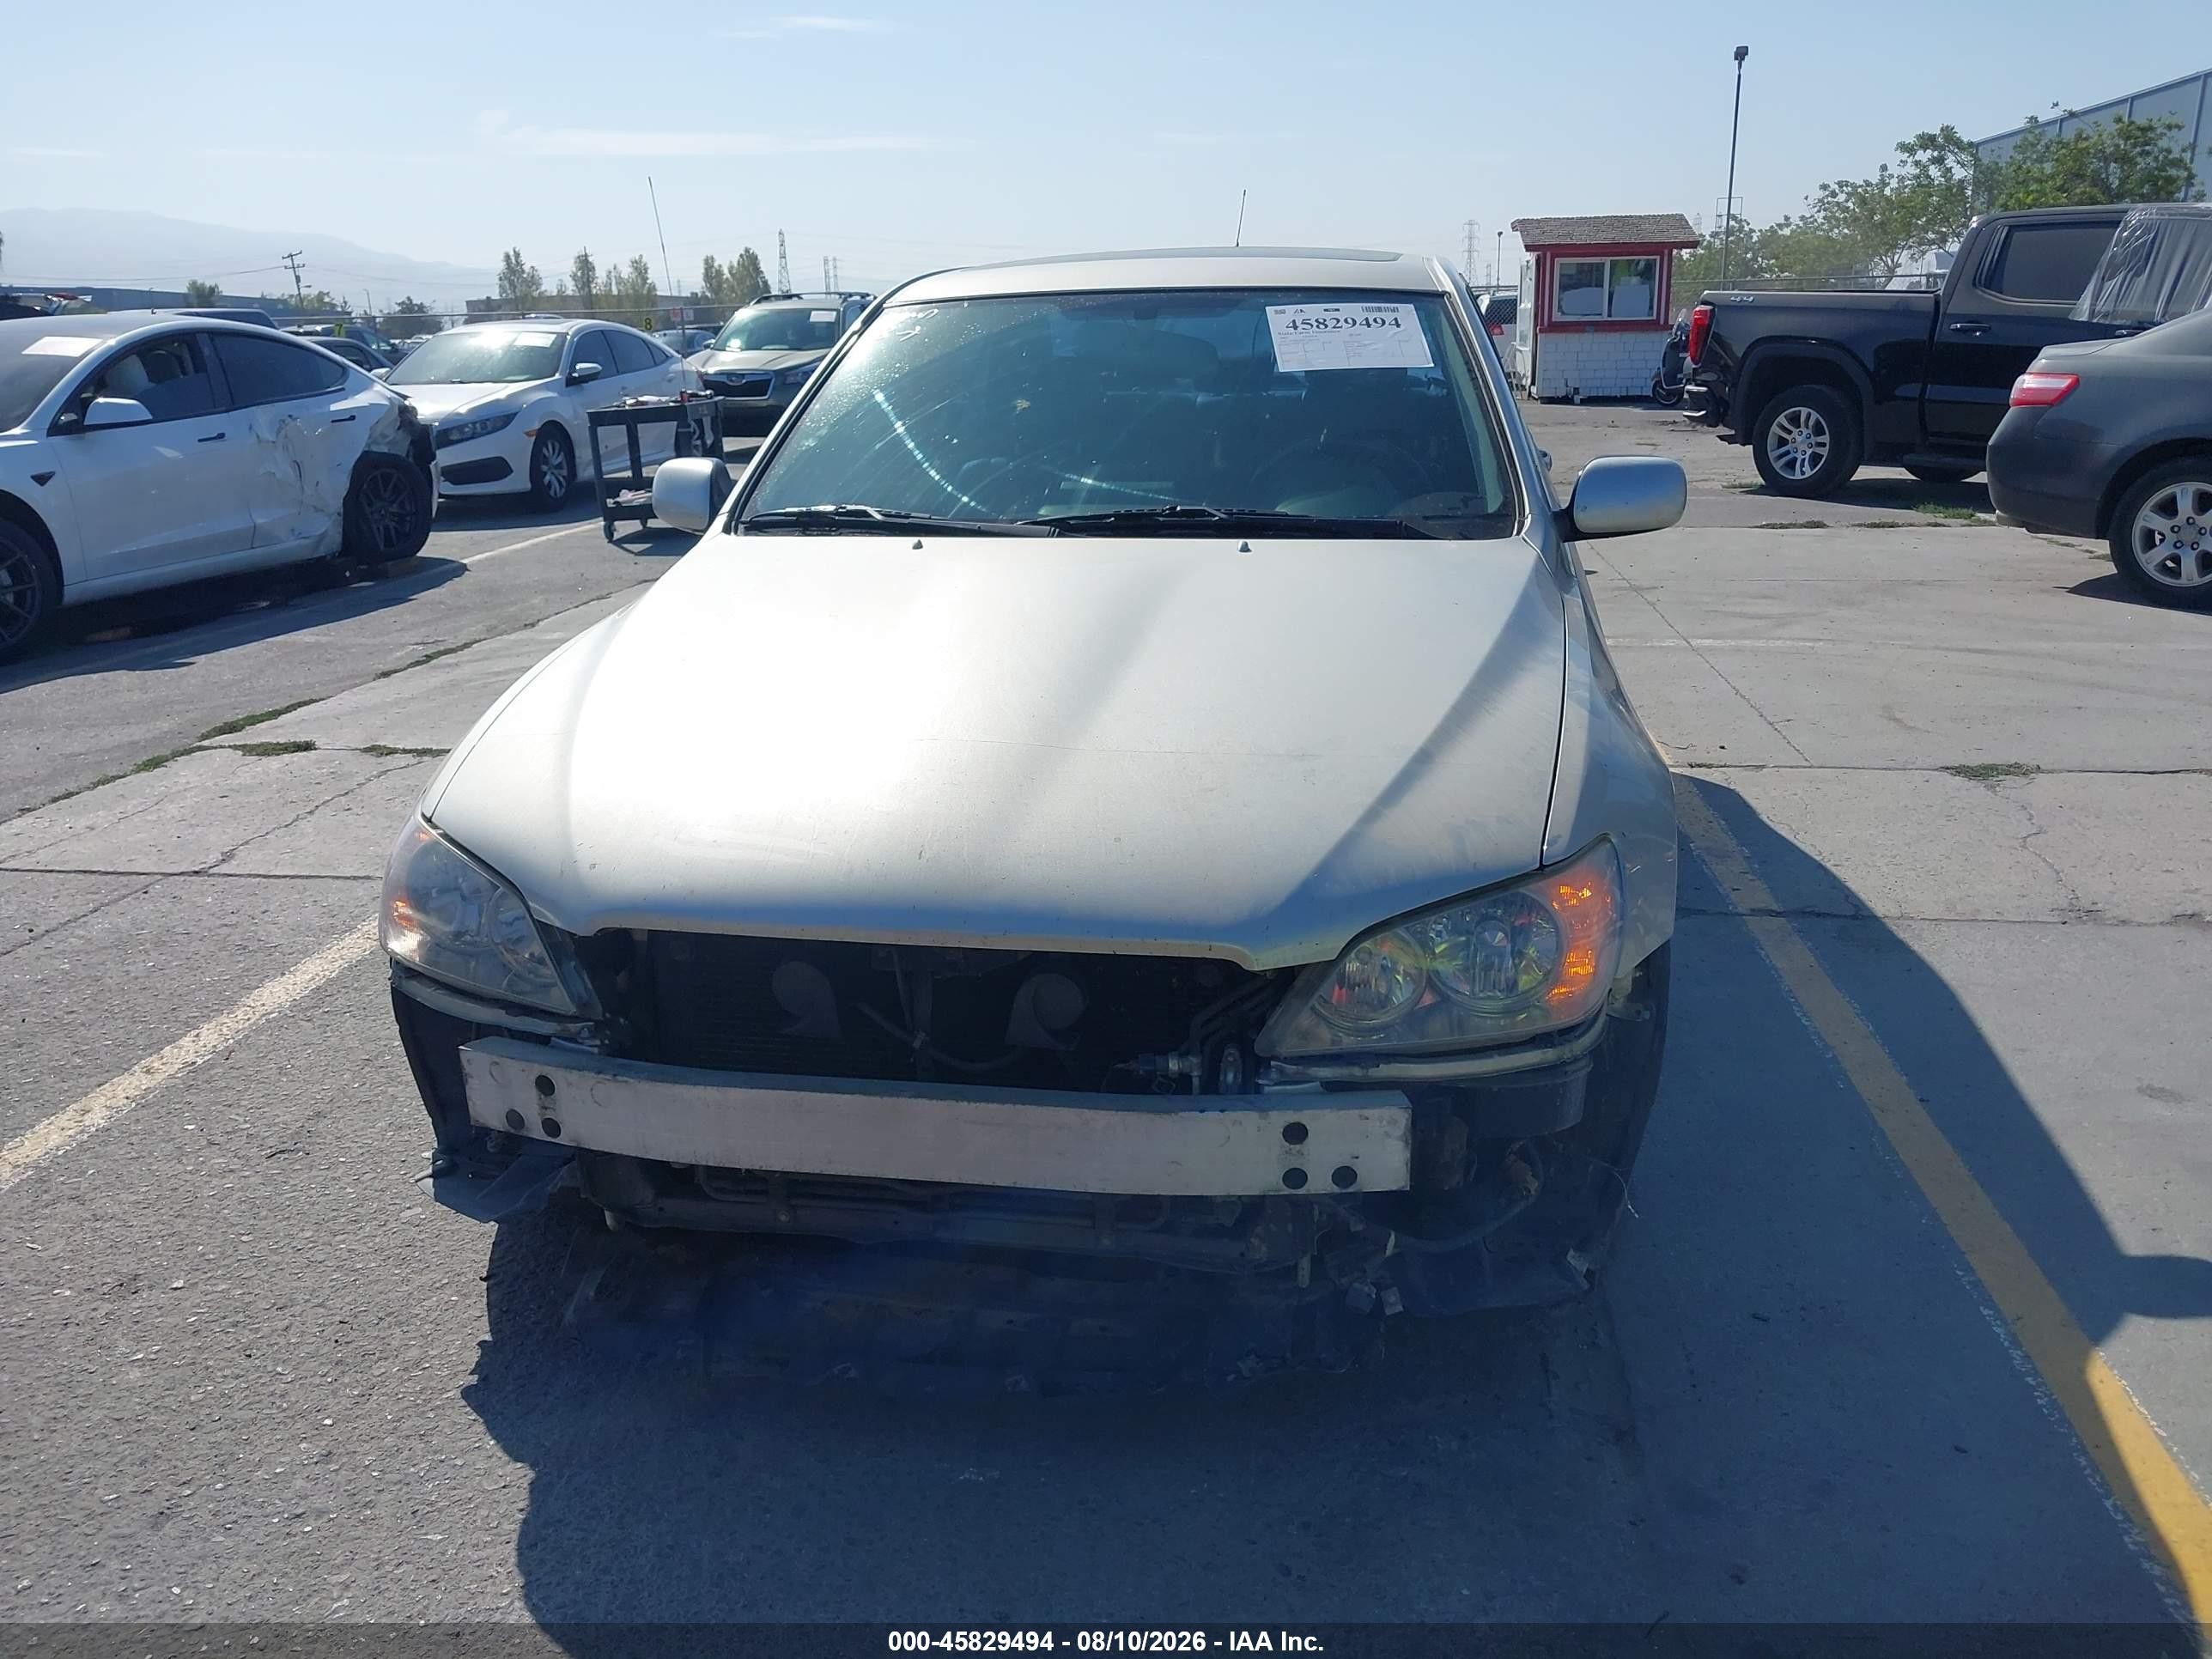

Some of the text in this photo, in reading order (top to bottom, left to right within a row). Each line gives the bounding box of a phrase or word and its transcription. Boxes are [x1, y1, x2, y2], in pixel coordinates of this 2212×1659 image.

[335, 323, 343, 337] 7
[645, 318, 653, 331] 8
[1285, 316, 1402, 331] 45829494
